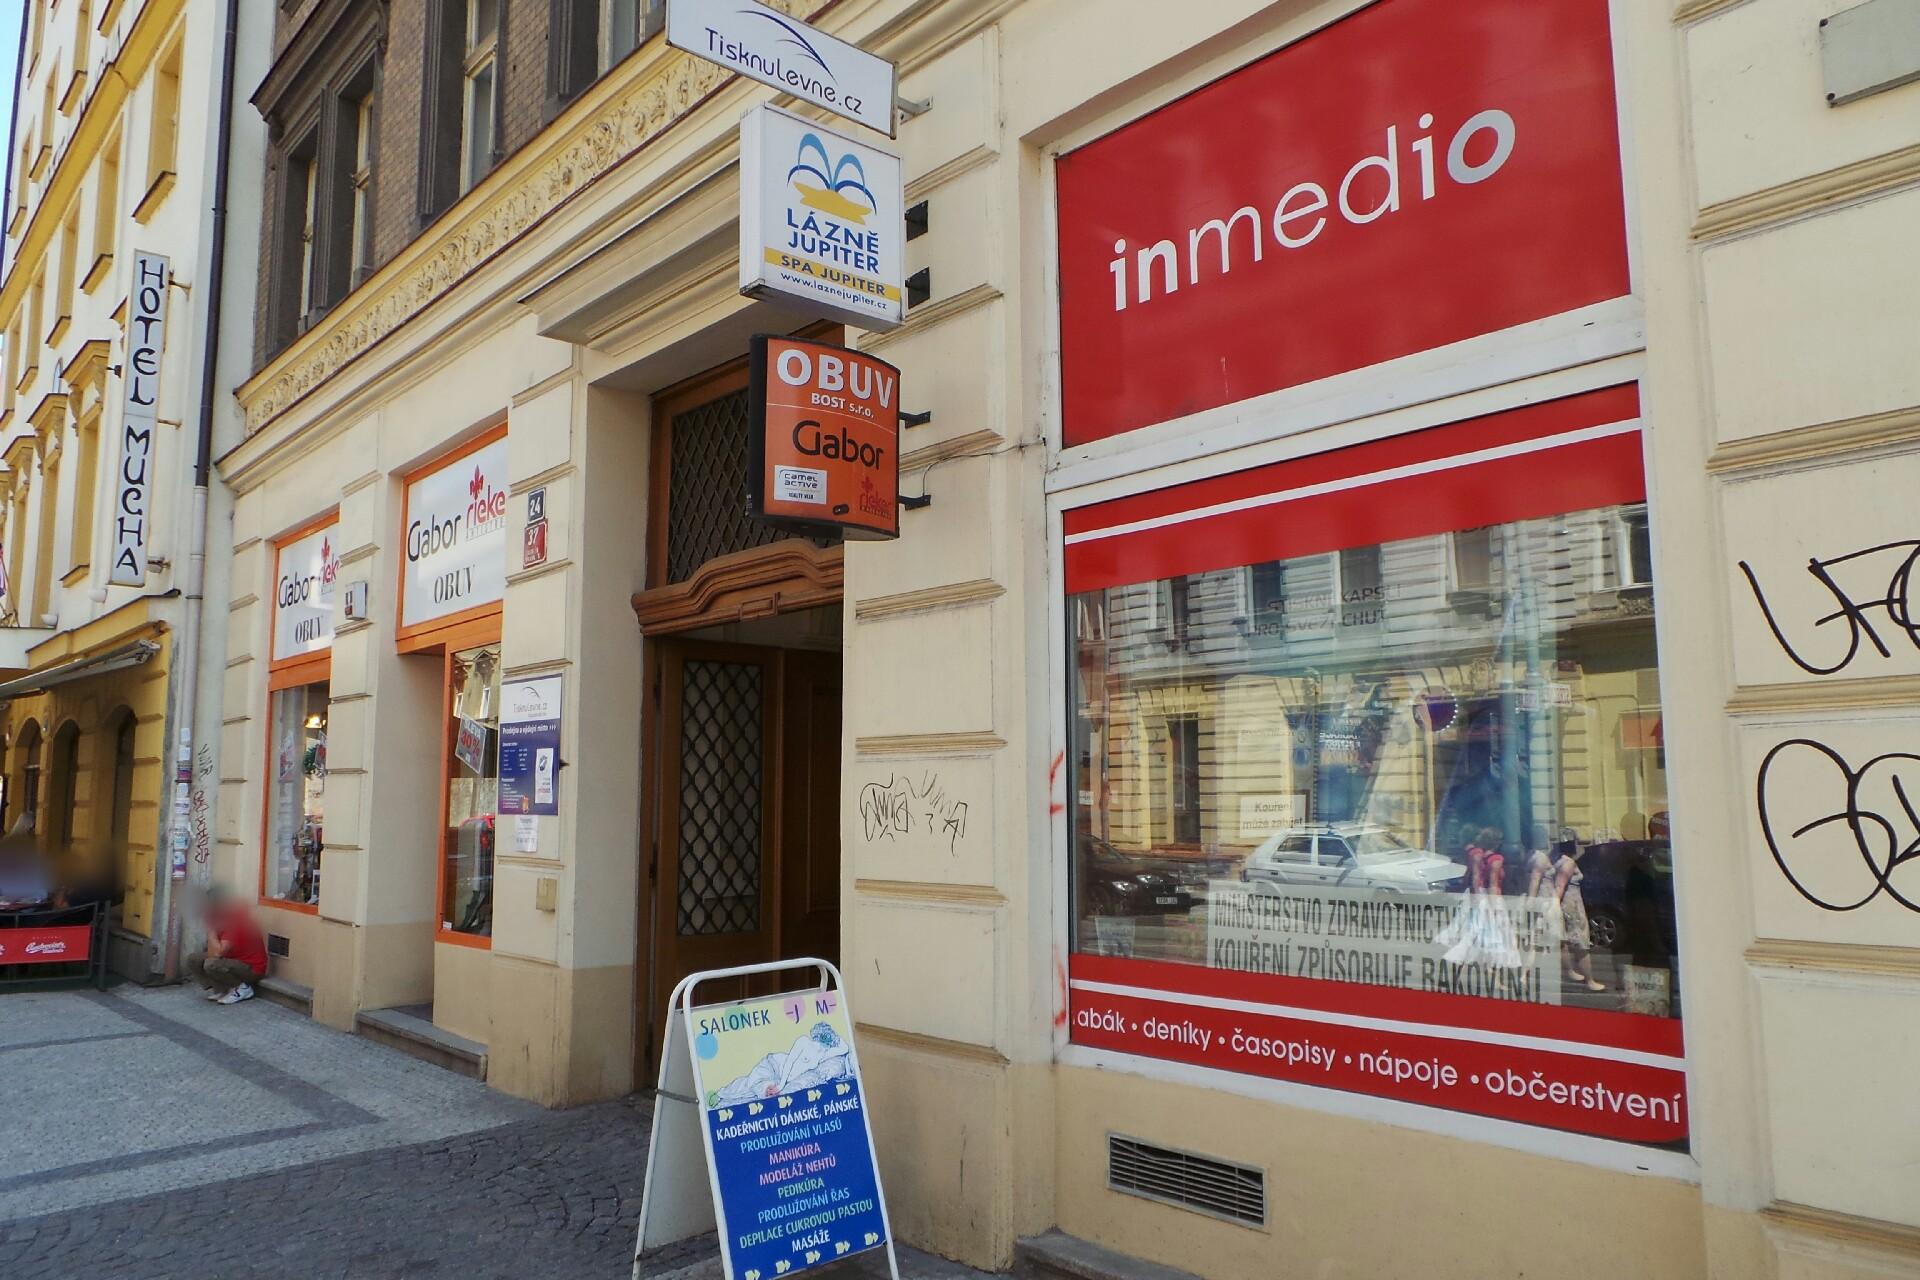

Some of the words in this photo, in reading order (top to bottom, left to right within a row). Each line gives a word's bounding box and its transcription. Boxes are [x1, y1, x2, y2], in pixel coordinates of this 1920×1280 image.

[705, 27, 862, 115] Tisknulevne.cz
[787, 208, 879, 255] LÁZNĚ
[1110, 109, 1516, 311] inmedio
[788, 231, 880, 274] JUPITER
[781, 255, 813, 275] SPA
[820, 267, 885, 296] JUPITER
[781, 272, 887, 310] www.laznejupiter.cz
[129, 259, 165, 405] HOTEL
[777, 349, 893, 408] OBUV
[811, 393, 845, 409] BOST
[849, 403, 874, 418] s.r.o.
[792, 420, 884, 470] Gabor
[116, 425, 151, 576] MUCHA
[408, 514, 461, 562] Gabor
[279, 572, 315, 608] Gabor
[434, 565, 475, 604] OBUV
[1215, 892, 1322, 935] MINISTERSTVO
[1214, 934, 1292, 977] KOUŘENÍ
[1297, 939, 1413, 990] ZPŮSOBUJE
[700, 1009, 771, 1035] SALONEK
[1075, 1008, 1126, 1033] abák
[1143, 1017, 1212, 1051] deníky
[1231, 1028, 1336, 1071] časopisy
[1359, 1050, 1458, 1089] nápoje
[1485, 1069, 1681, 1123] občerstvení
[716, 1117, 778, 1141] KADEŘNICTVÍ
[780, 1107, 822, 1126] DÁMSKÉ,
[824, 1097, 859, 1116] PÁNSKÉ
[740, 1126, 810, 1153] PRODLUŽOVÁNÍ
[759, 1163, 804, 1185] MODELÁŽ
[769, 1142, 821, 1165] MANIKÚRA
[758, 1195, 828, 1223] PRODLUŽOVÁNÍ
[831, 1187, 850, 1202] ŘAS
[778, 1177, 825, 1199] PEDIKÚRA
[739, 1225, 783, 1249] DEPILACE
[786, 1210, 836, 1233] CUKROVOU
[838, 1199, 873, 1217] PASTOU
[791, 1230, 830, 1253] MASÁŽE
